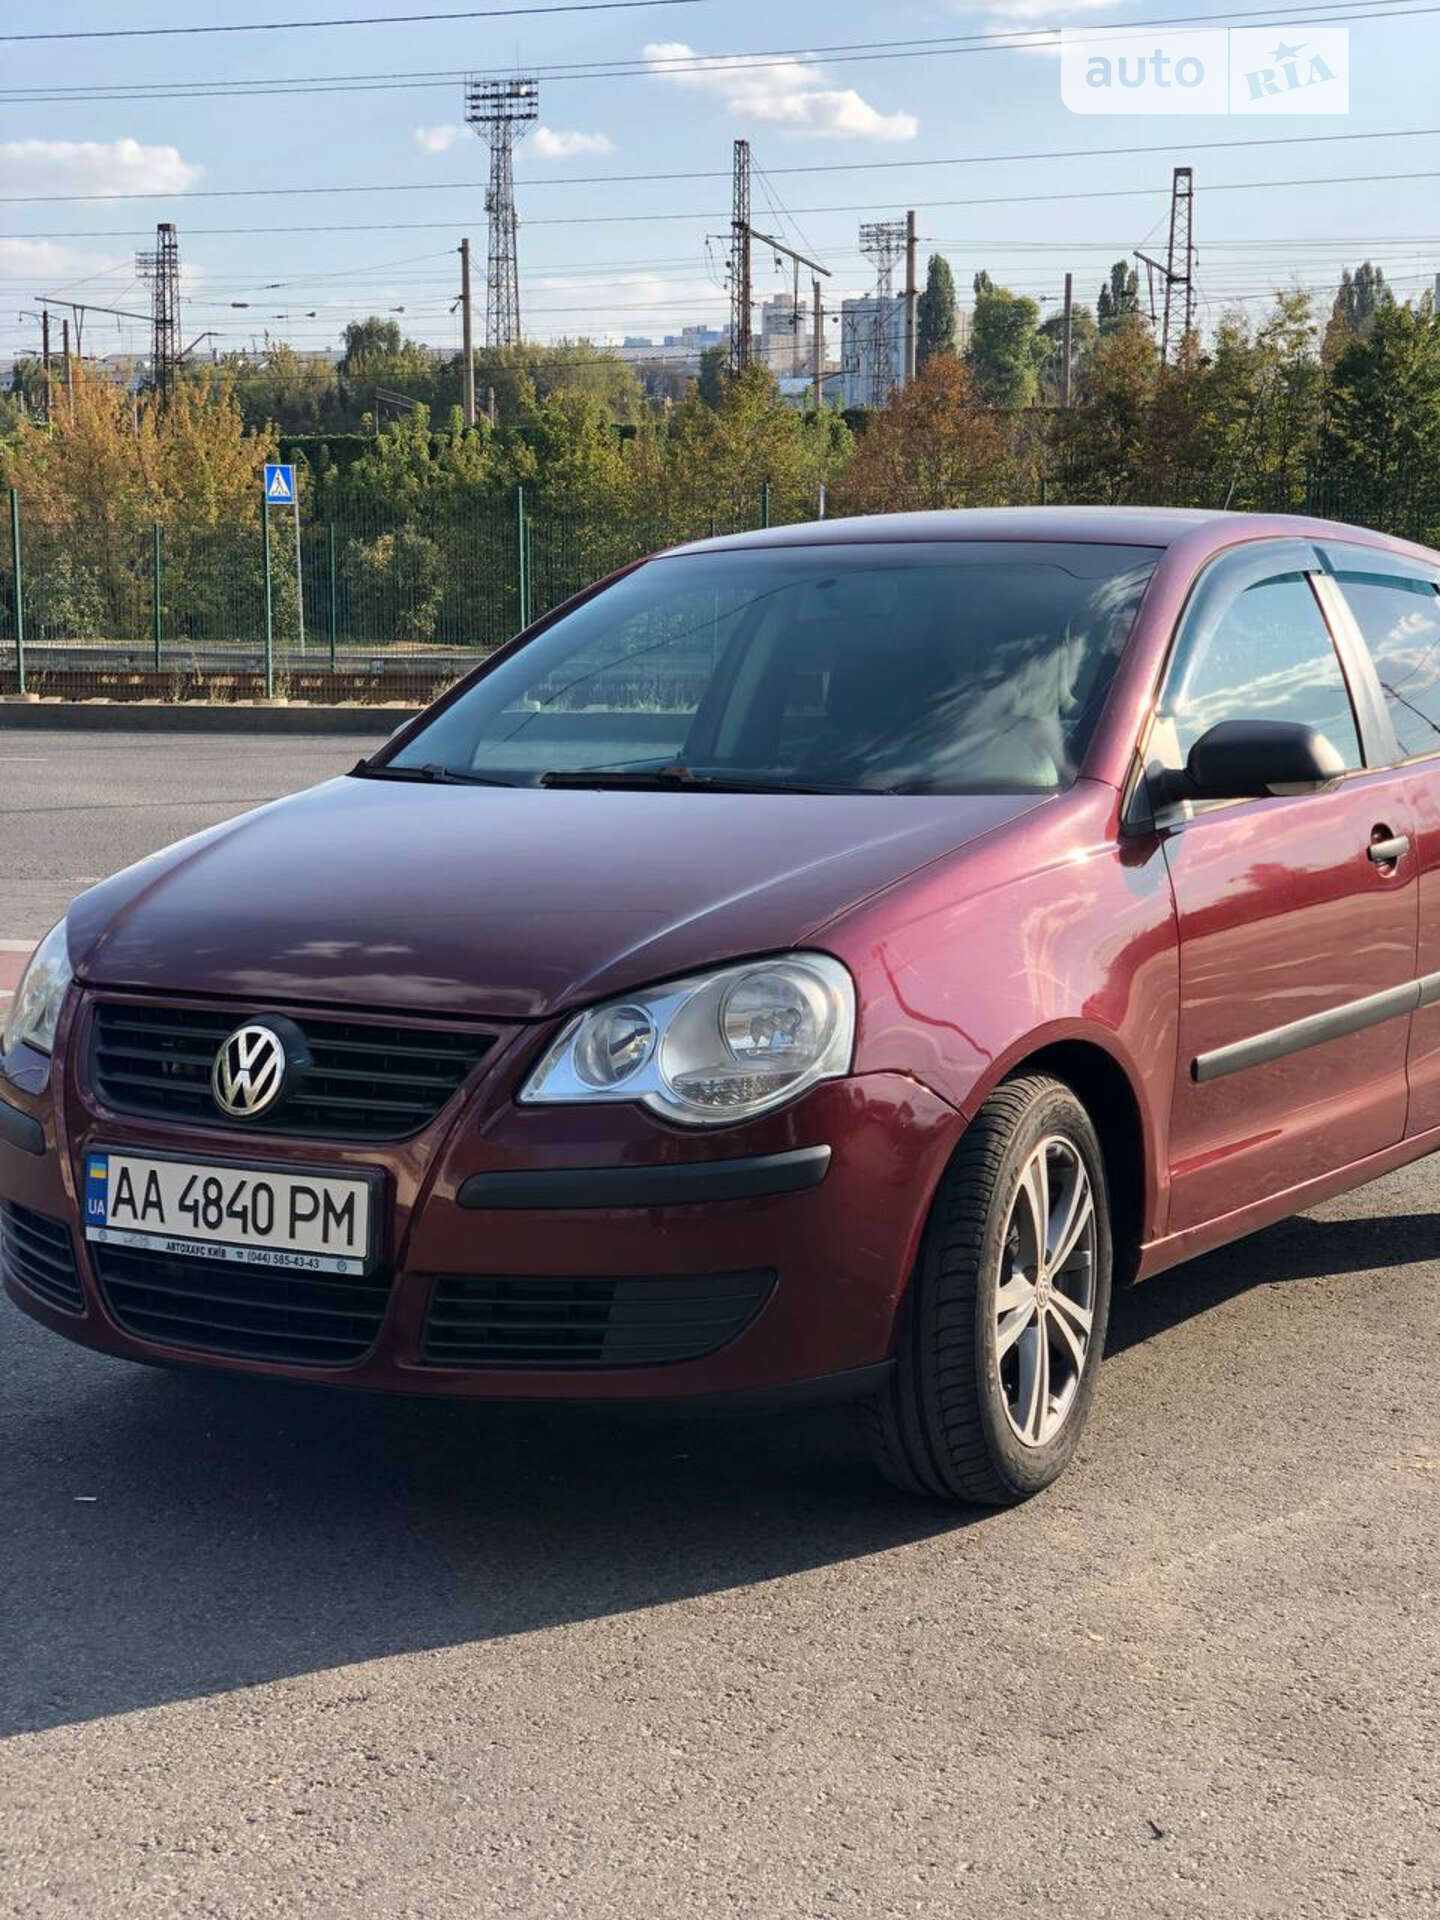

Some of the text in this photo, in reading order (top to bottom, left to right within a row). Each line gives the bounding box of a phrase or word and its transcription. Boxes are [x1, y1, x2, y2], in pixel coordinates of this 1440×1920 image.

[88, 1198, 105, 1216] UA
[111, 1166, 355, 1246] AA 4840 PM
[166, 1241, 206, 1256] АВТОХАУС
[247, 1250, 271, 1264] (044)
